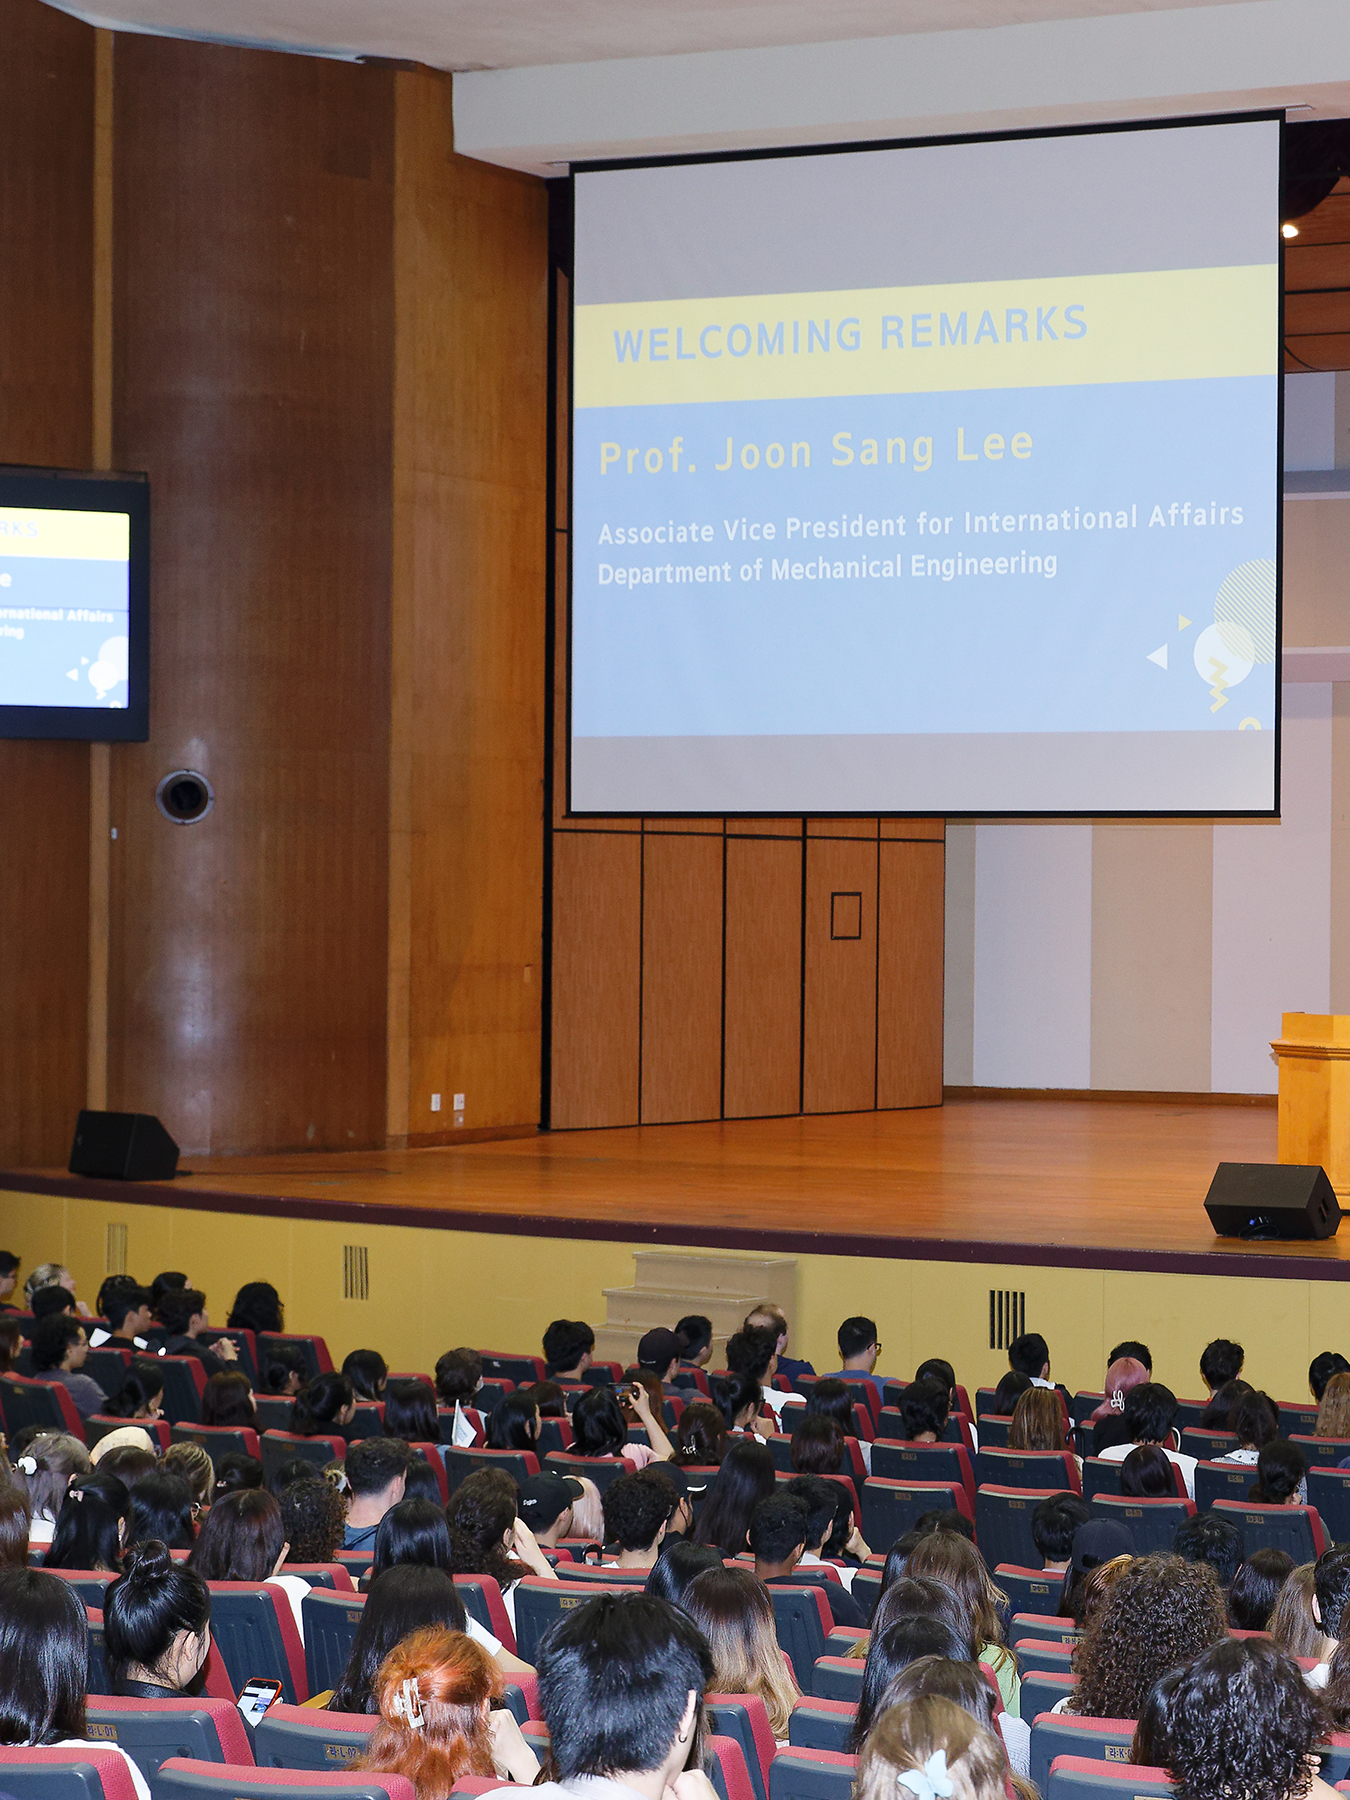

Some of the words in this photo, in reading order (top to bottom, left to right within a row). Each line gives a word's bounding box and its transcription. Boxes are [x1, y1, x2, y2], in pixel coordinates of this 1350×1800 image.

[613, 316, 861, 364] WELCOMING
[881, 304, 1088, 350] REMARKS
[600, 435, 697, 475] Prof.
[714, 436, 811, 471] Joon
[832, 431, 933, 472] Sang
[957, 427, 1033, 462] Lee
[597, 519, 715, 546] Associate
[722, 517, 776, 541] Vice
[785, 513, 907, 540] President
[916, 511, 954, 535] for
[964, 503, 1137, 533] International
[1148, 500, 1245, 528] Affairs
[597, 560, 732, 590] Department
[739, 557, 763, 582] of
[771, 553, 902, 581] Mechanical
[911, 550, 1058, 582] Engineering
[66, 608, 115, 623] Affairs
